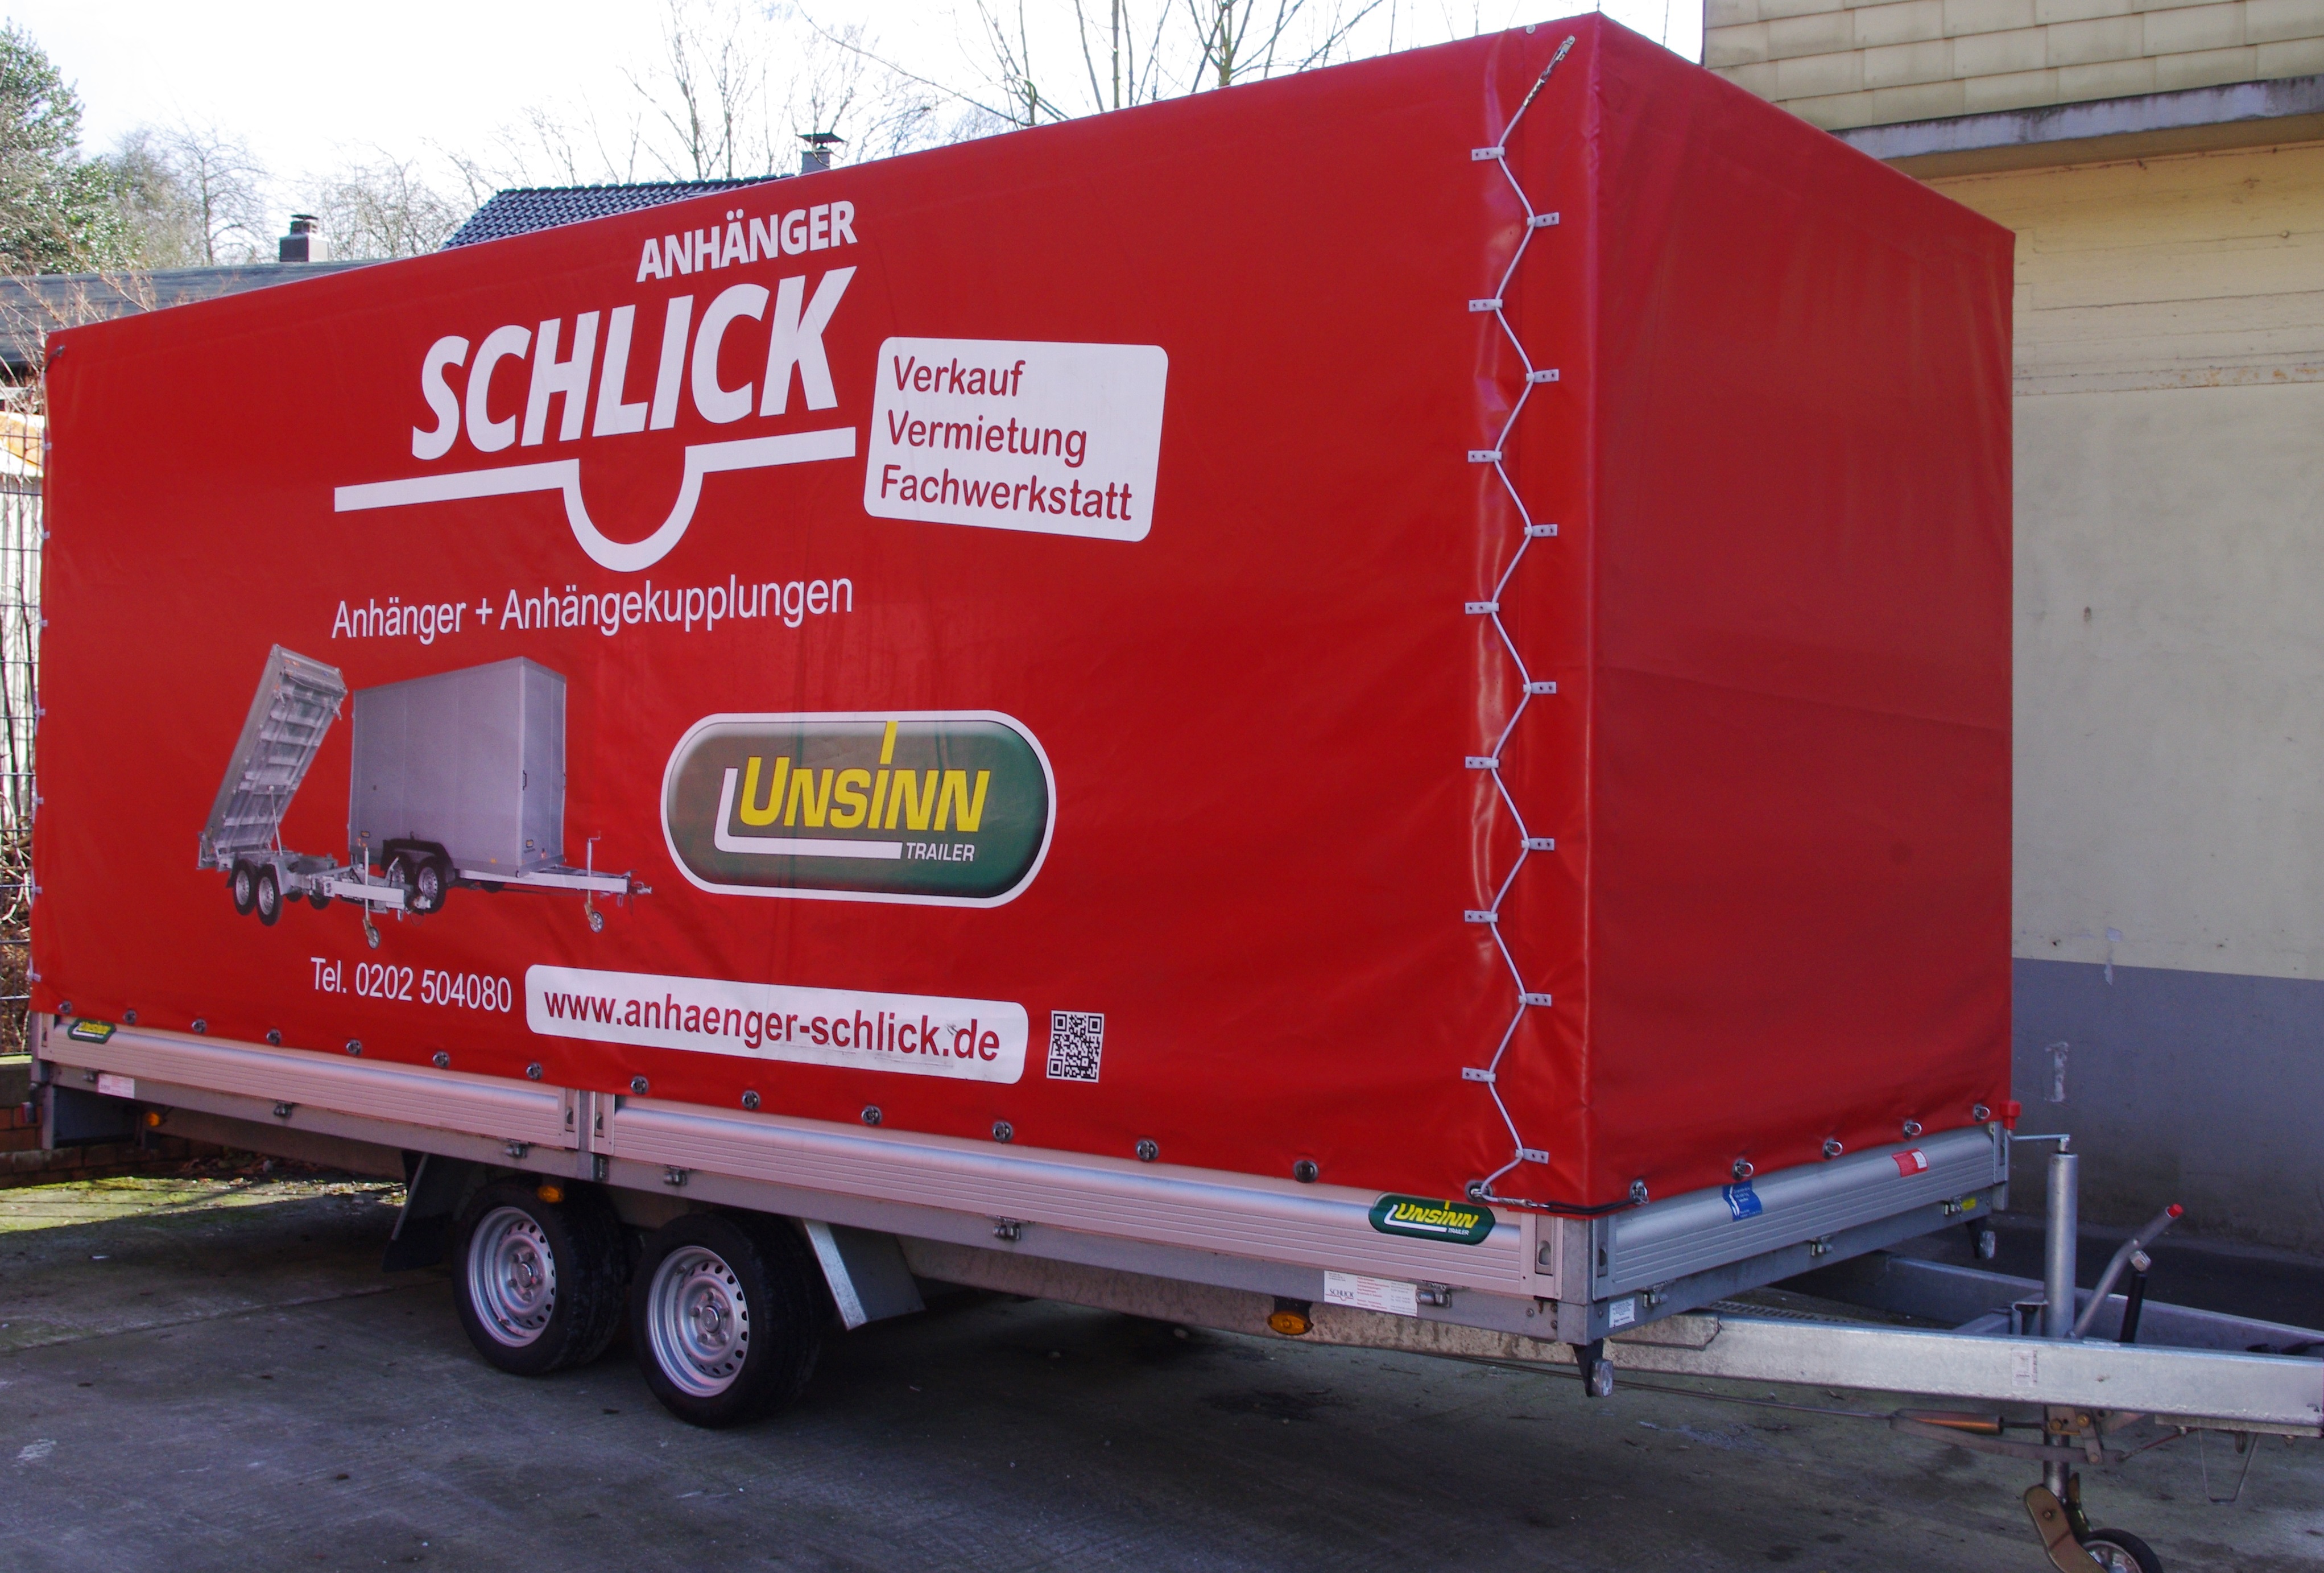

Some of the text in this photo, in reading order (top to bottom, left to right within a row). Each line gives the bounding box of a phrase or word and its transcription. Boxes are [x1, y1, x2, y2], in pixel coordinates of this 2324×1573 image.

[636, 200, 857, 282] ANHÄNGER
[411, 266, 857, 460] SCHLICK
[894, 355, 1026, 397] Verkauf
[888, 409, 1087, 468] Vermietung
[880, 464, 1132, 521] Fachwerkstatt
[332, 575, 853, 645] Anhänger + Anhängekupplungen
[906, 842, 975, 862] TRAILER
[311, 956, 512, 1013] Tel. 0202 504080
[544, 991, 999, 1062] www.anhaenger-schlick.de
[1448, 1227, 1470, 1236] TRAILER
